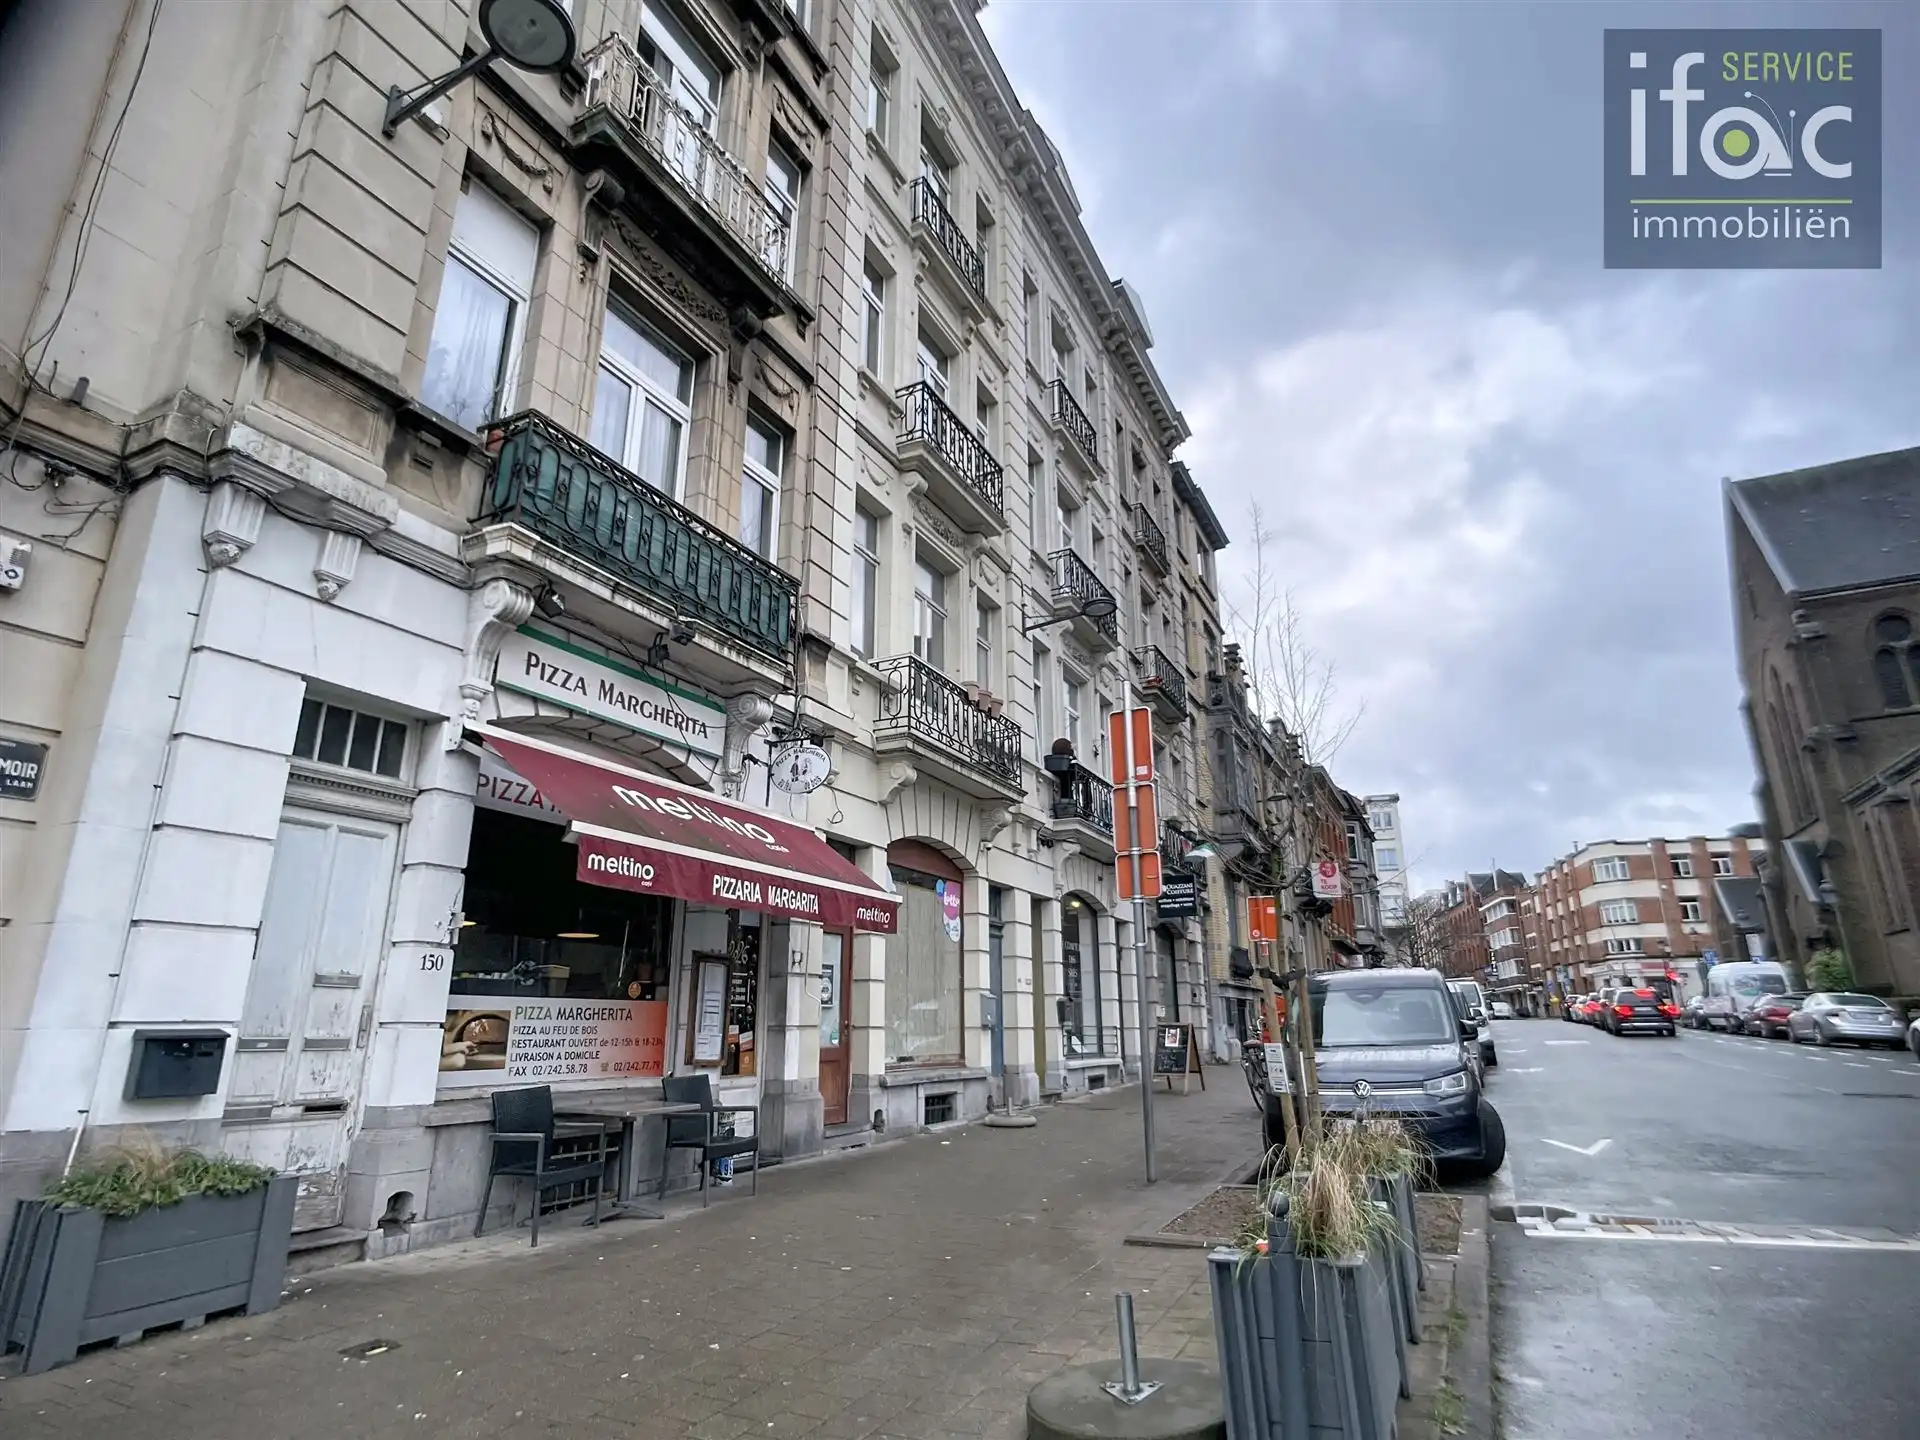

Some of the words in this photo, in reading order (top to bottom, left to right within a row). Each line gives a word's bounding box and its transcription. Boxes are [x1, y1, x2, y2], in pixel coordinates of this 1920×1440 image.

[525, 651, 587, 697] PIZZA
[598, 679, 709, 739] MARGHERITA
[7, 779, 34, 789] LAAN
[477, 773, 544, 809] PIZZA
[612, 785, 775, 844] meltino
[587, 853, 655, 881] meltino
[712, 875, 762, 904] PIZZARIA
[768, 886, 819, 914] MARGARITA
[857, 907, 891, 923] meltino
[420, 954, 444, 971] 150
[515, 1005, 552, 1020] PIZZA
[556, 1006, 633, 1021] MARGHERITA
[513, 1025, 537, 1035] PIZZA
[539, 1026, 550, 1034] AU
[552, 1026, 567, 1034] FEU
[570, 1026, 579, 1034] DE
[582, 1025, 598, 1034] BOIS
[511, 1038, 567, 1049] RESTAURANT
[568, 1038, 598, 1048] OUVERT
[600, 1037, 609, 1047] de
[510, 1052, 554, 1062] LIVRAISON
[556, 1052, 562, 1061] A
[564, 1050, 600, 1060] DOMICILE
[508, 1066, 527, 1077] FAX
[532, 1064, 588, 1076] 02/242.58.78
